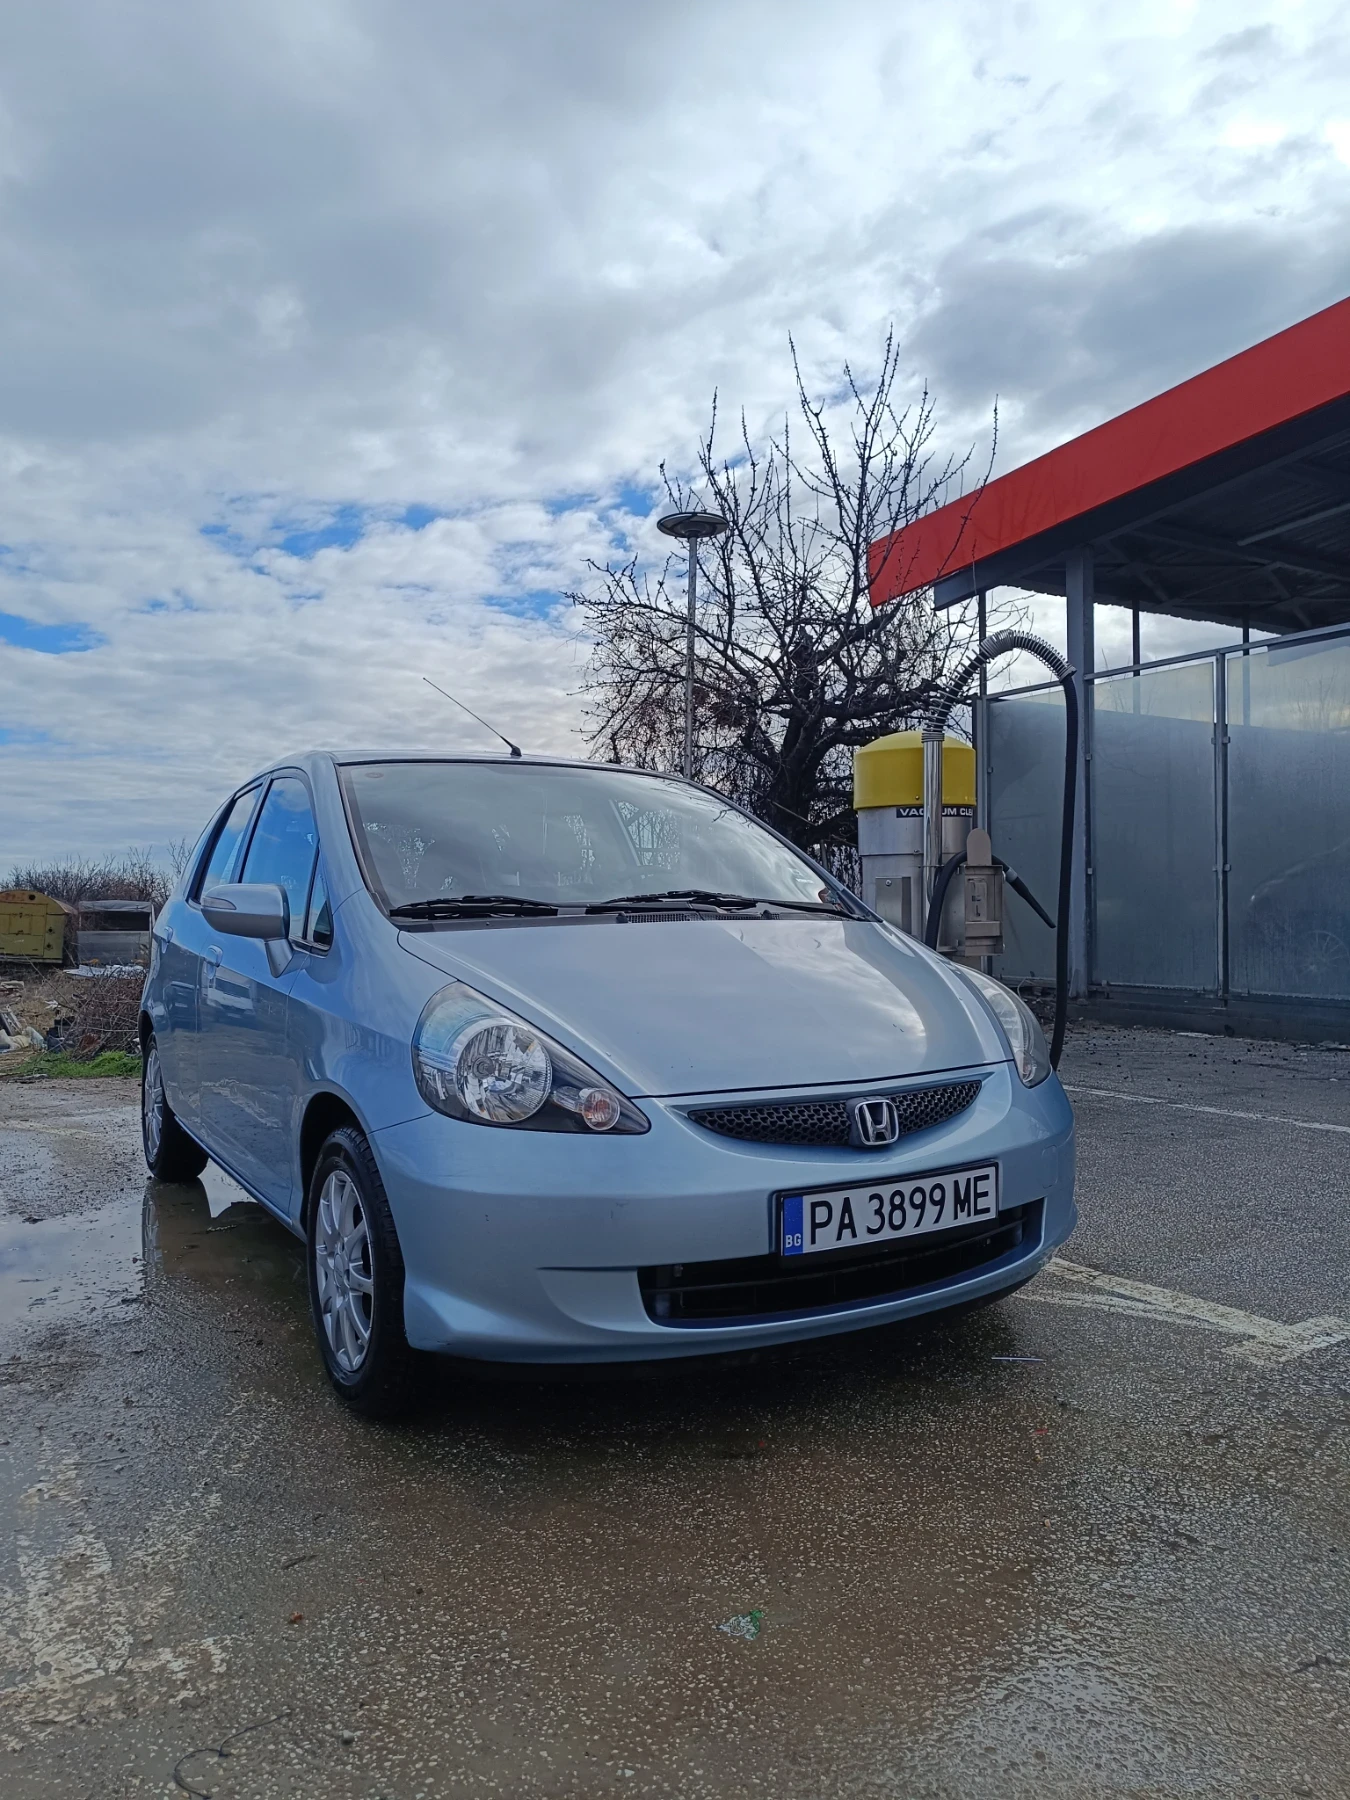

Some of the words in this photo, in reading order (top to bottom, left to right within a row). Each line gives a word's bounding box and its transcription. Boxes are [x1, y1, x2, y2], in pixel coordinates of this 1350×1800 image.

[900, 808, 957, 816] VACUM
[810, 1197, 857, 1245] PA
[866, 1183, 946, 1235] 3899
[953, 1173, 991, 1221] ME
[785, 1233, 802, 1248] BG
